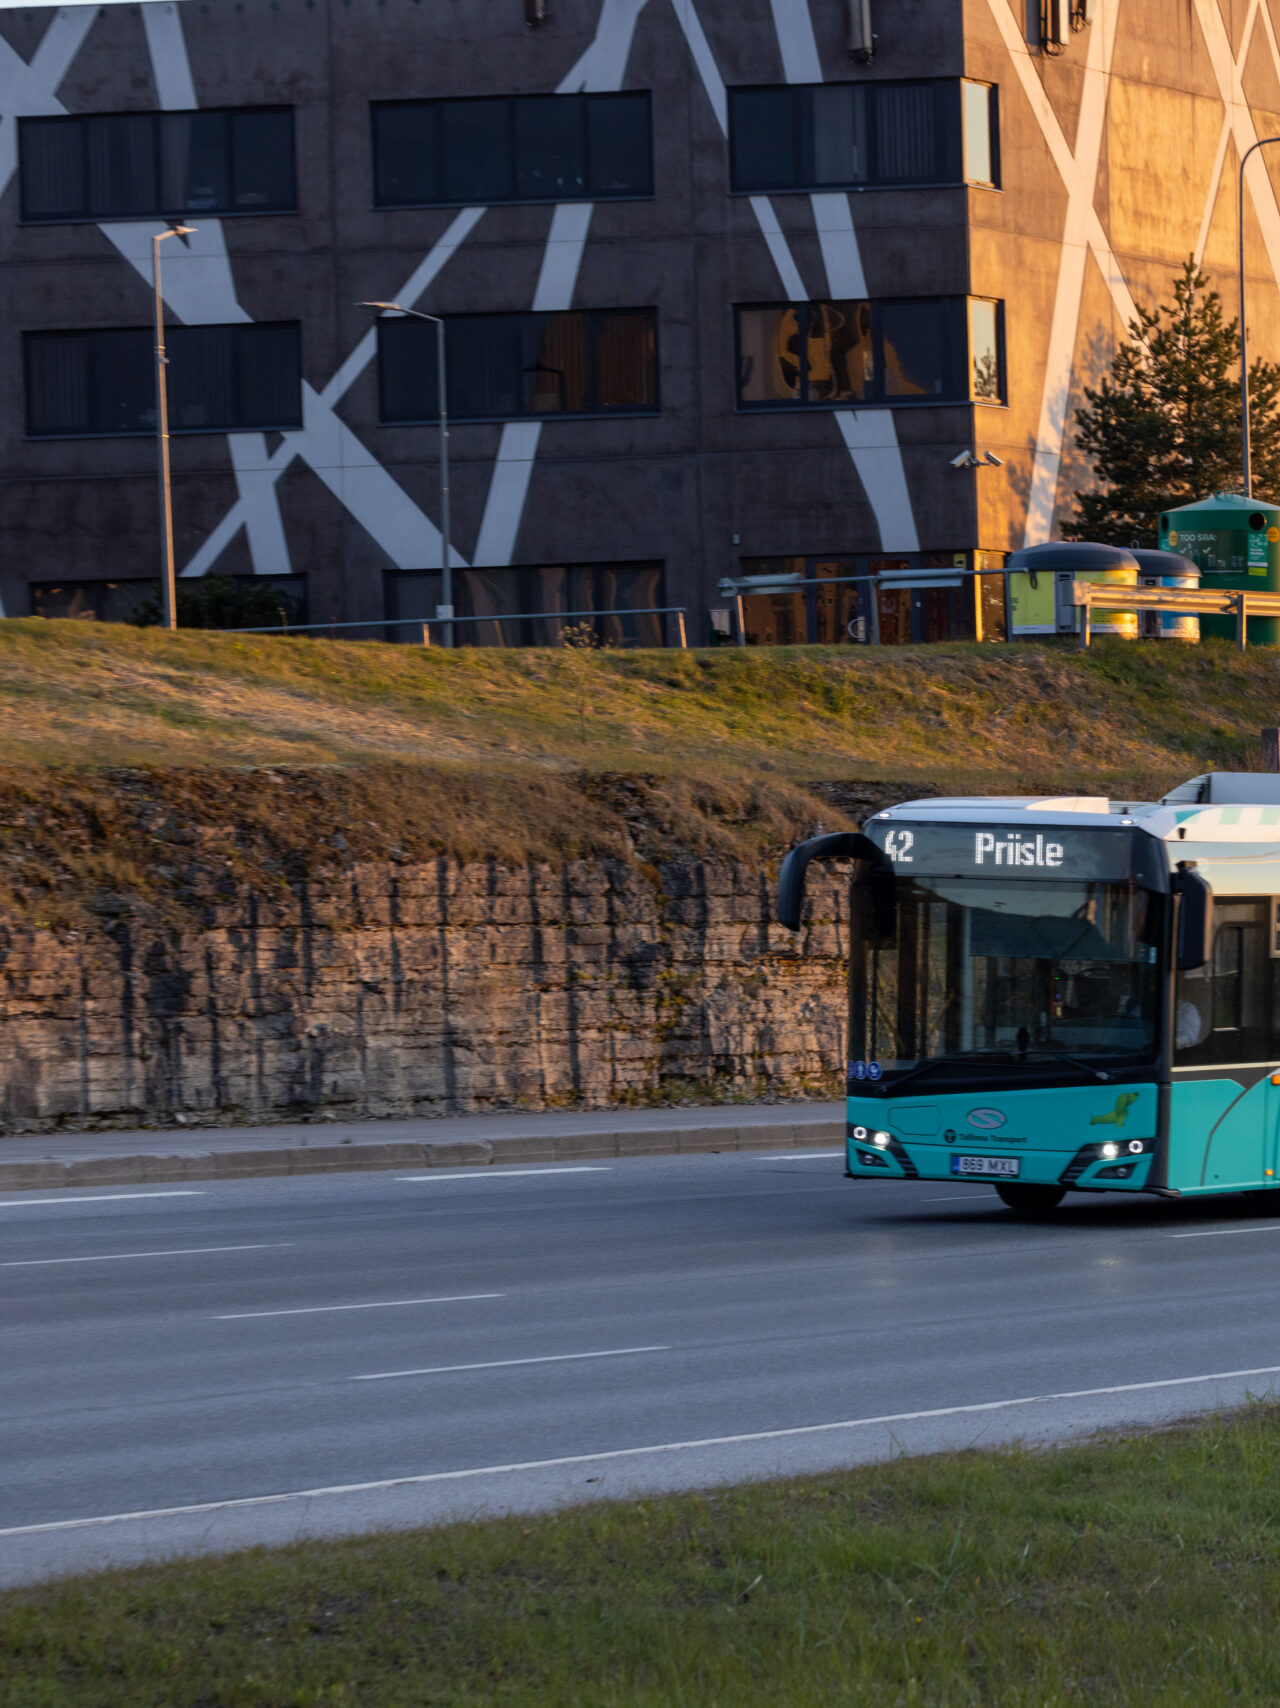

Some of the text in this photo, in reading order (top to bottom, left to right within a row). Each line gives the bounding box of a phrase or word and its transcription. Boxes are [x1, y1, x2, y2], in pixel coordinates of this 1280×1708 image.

[1180, 534, 1196, 542] TOO
[884, 830, 1064, 866] 42 Priisle
[962, 1158, 1016, 1174] 869 MXL
